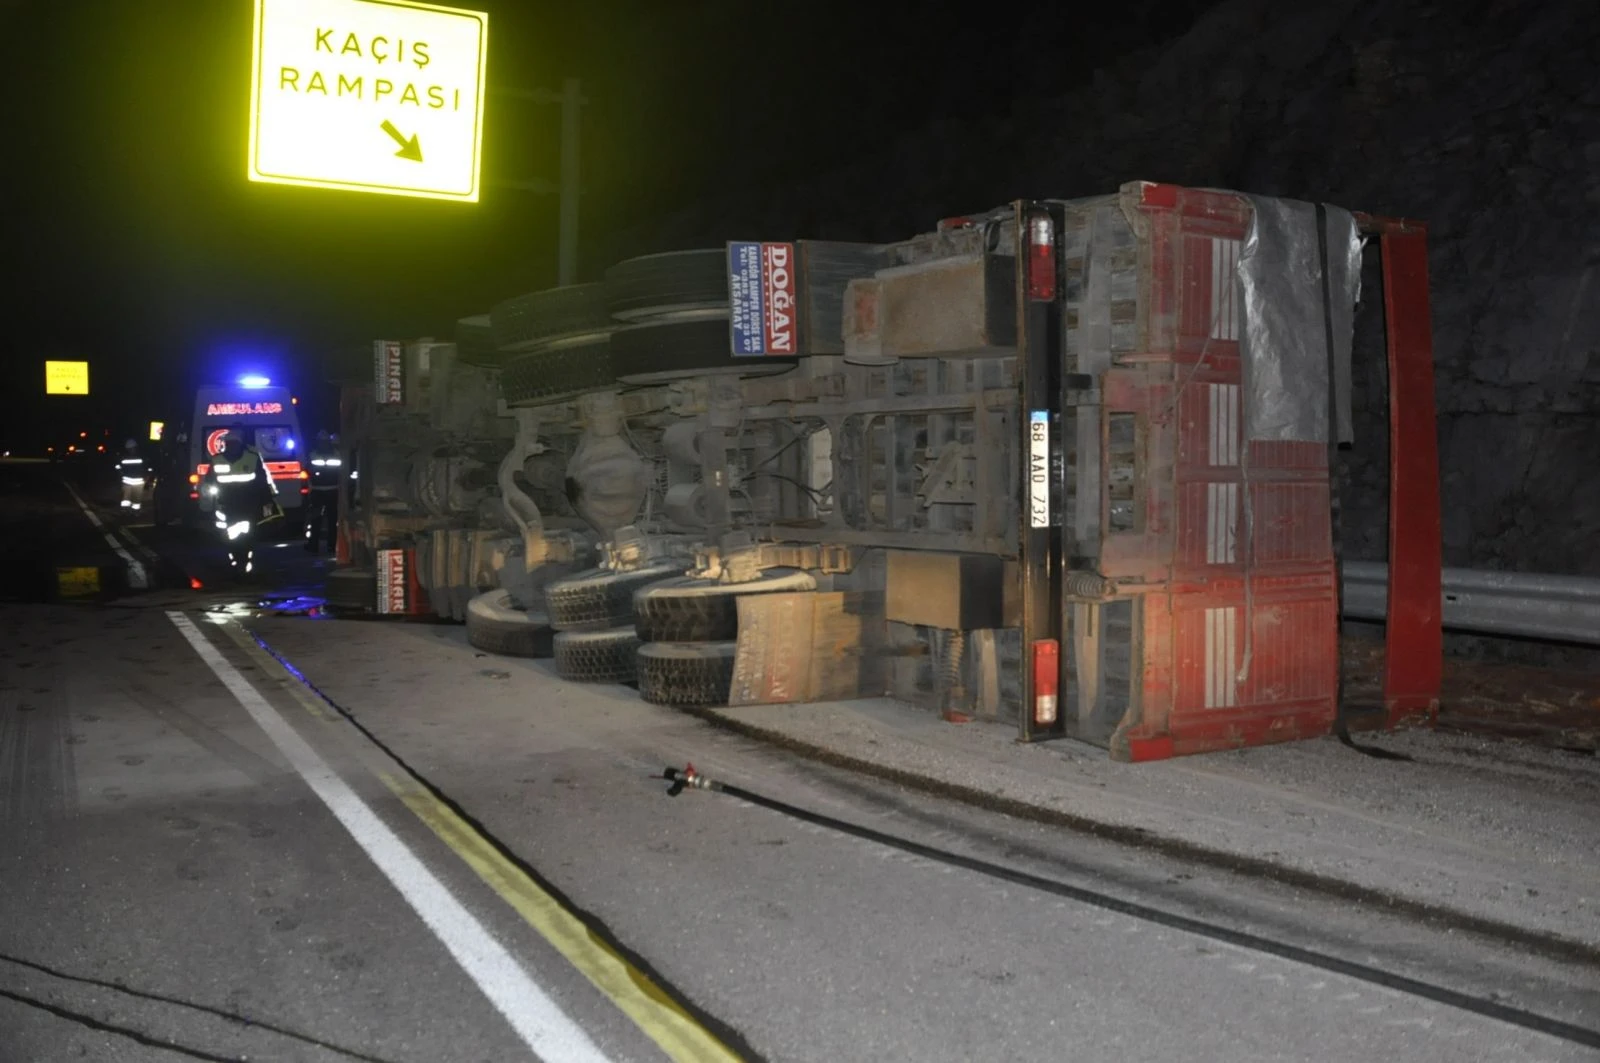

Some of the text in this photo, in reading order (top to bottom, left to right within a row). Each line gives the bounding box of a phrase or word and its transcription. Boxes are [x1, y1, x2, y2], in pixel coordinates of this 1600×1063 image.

[315, 27, 430, 70] KAÇIŞ
[279, 66, 459, 111] RAMPASI
[732, 274, 742, 330] AKSARAY
[749, 280, 760, 310] DAMPER
[771, 246, 795, 351] DOĞAN
[744, 338, 751, 353] 07
[389, 346, 401, 402] PINAR
[207, 403, 282, 415] AMBULANS
[1032, 422, 1046, 524] 68 AAD 732
[392, 554, 404, 612] PINAR
